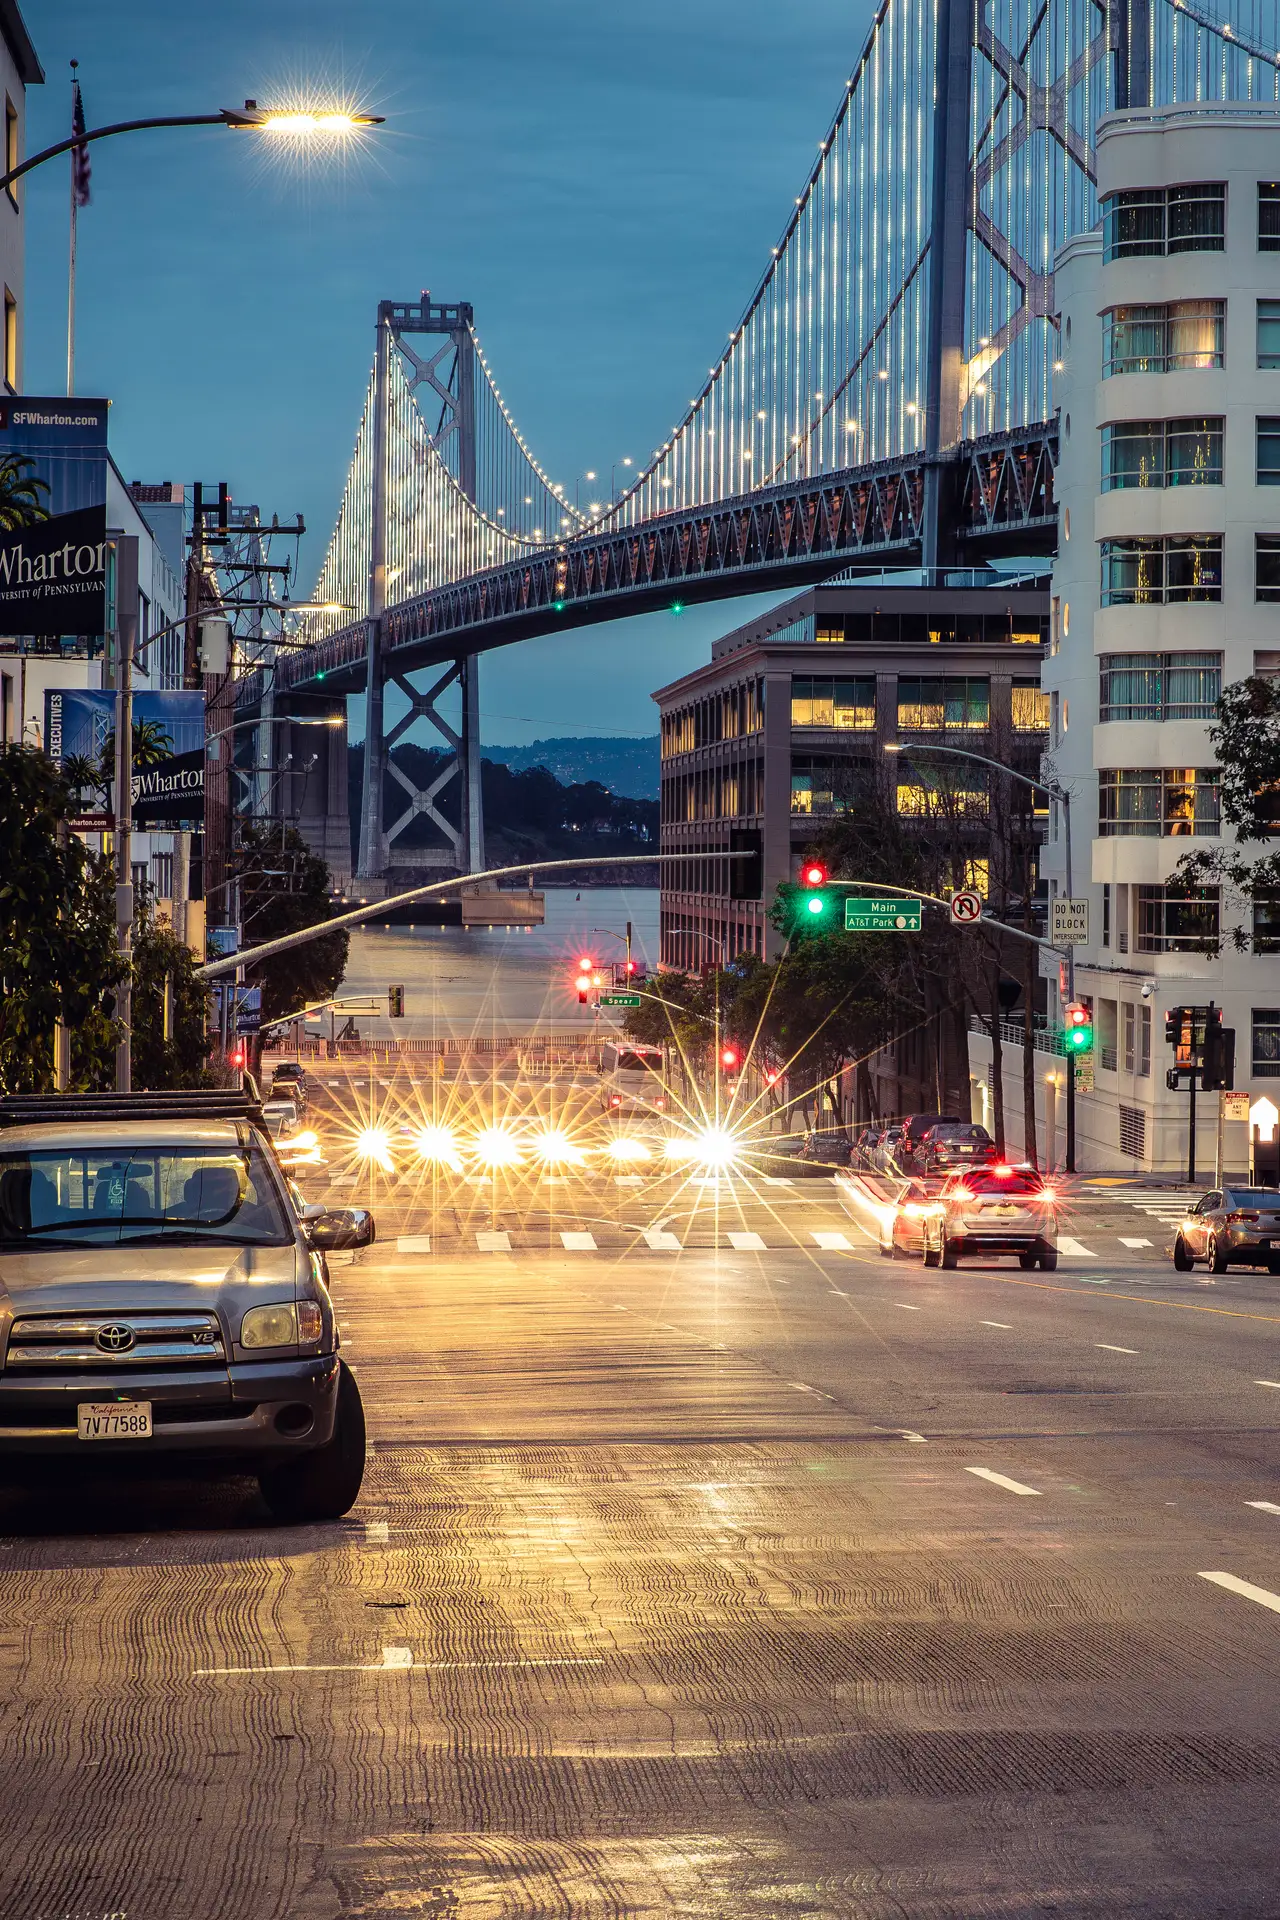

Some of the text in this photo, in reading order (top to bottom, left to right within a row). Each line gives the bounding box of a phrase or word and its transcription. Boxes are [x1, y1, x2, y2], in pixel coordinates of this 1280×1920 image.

[13, 412, 98, 426] SFWharton.com
[0, 580, 106, 600] VERSITY of PENNSYLVAN
[50, 694, 62, 757] EXECUTIVES
[170, 789, 205, 800] PENNSYLVAN
[871, 902, 897, 912] Main
[1055, 904, 1086, 914] DO NOT
[848, 917, 894, 927] AT&T Park
[1055, 919, 1085, 929] BLOCK
[608, 997, 633, 1005] Spear
[192, 1332, 215, 1344] V8
[93, 1404, 137, 1415] California
[82, 1415, 148, 1434] 7V77588
